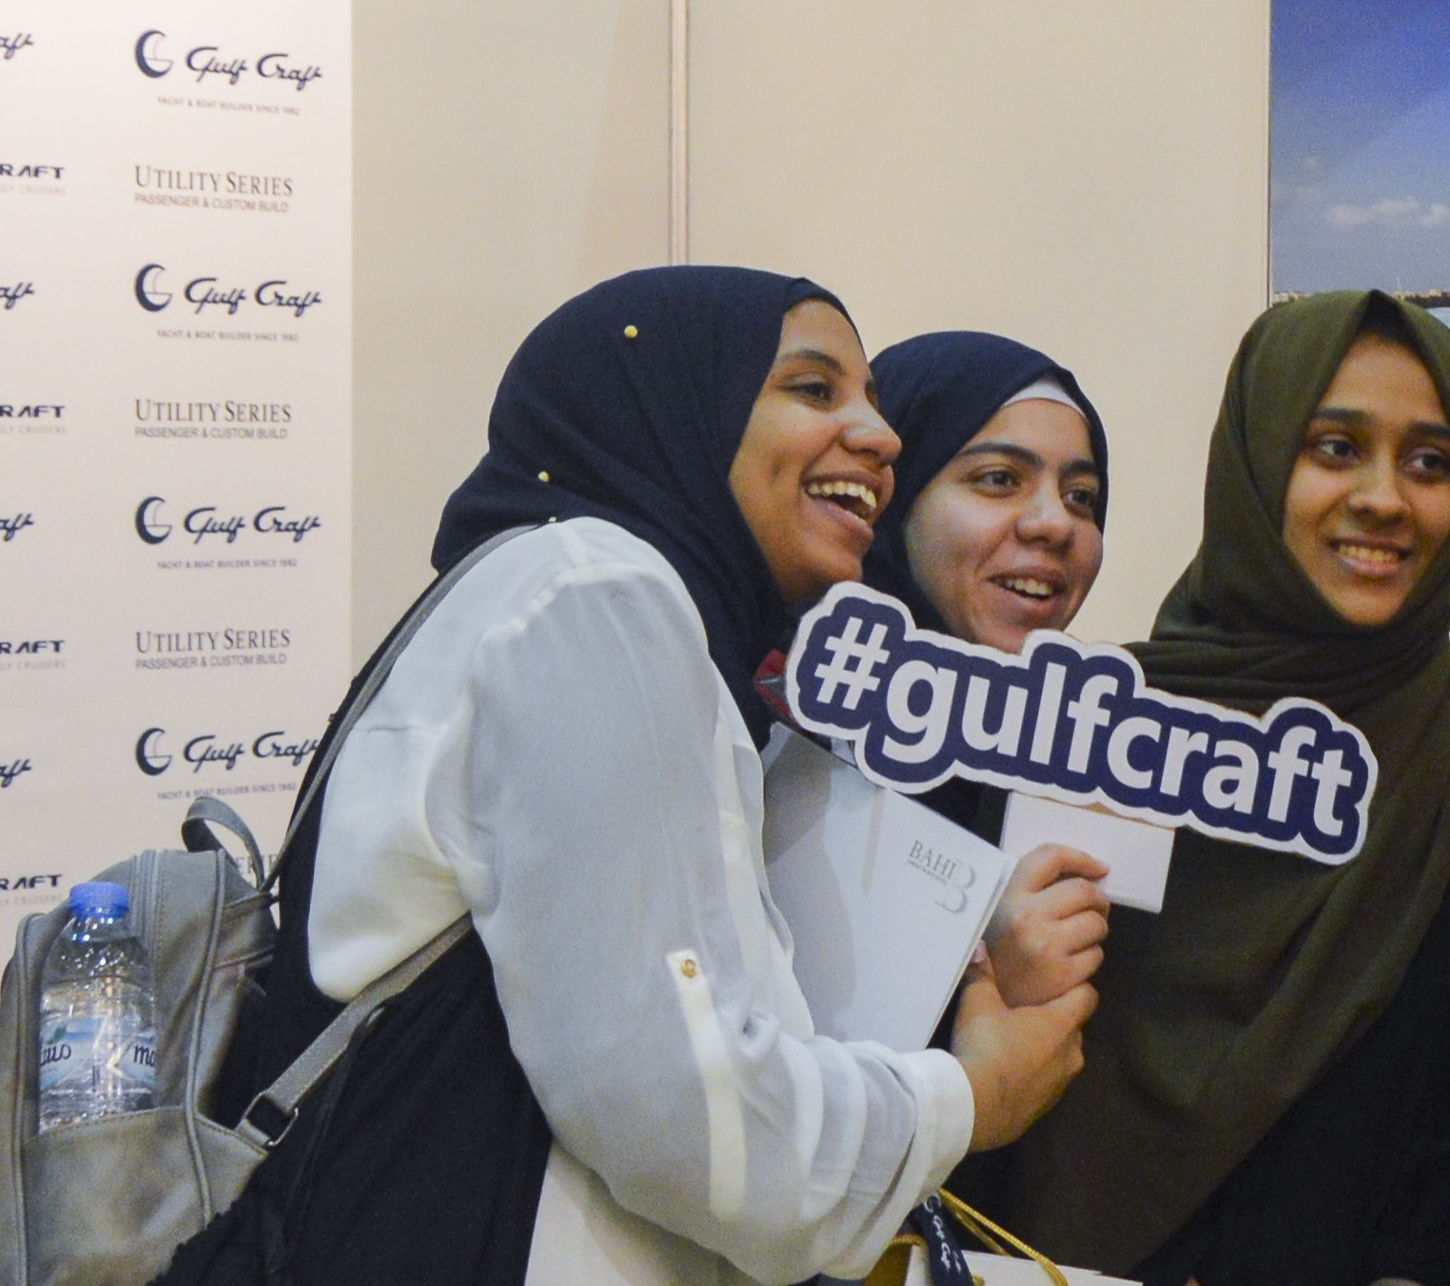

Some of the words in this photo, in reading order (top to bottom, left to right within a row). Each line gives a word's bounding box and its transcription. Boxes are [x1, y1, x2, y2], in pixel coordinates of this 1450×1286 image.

[185, 45, 248, 86] Gulf
[255, 52, 322, 91] Craft
[134, 164, 222, 193] UTILITY
[225, 170, 294, 197] SERIES
[184, 276, 247, 315] Gulf
[254, 280, 323, 318] Craft
[134, 398, 221, 423] UTILITY
[224, 400, 292, 423] SERIES
[183, 506, 247, 544] Gulf
[253, 505, 322, 543] Craft
[135, 630, 220, 654] UTILITY
[223, 628, 291, 650] SERIES
[813, 615, 1353, 838] #gulfcraft
[183, 734, 245, 773] Gulf
[252, 730, 320, 767] Craft
[910, 839, 958, 880] BAHI
